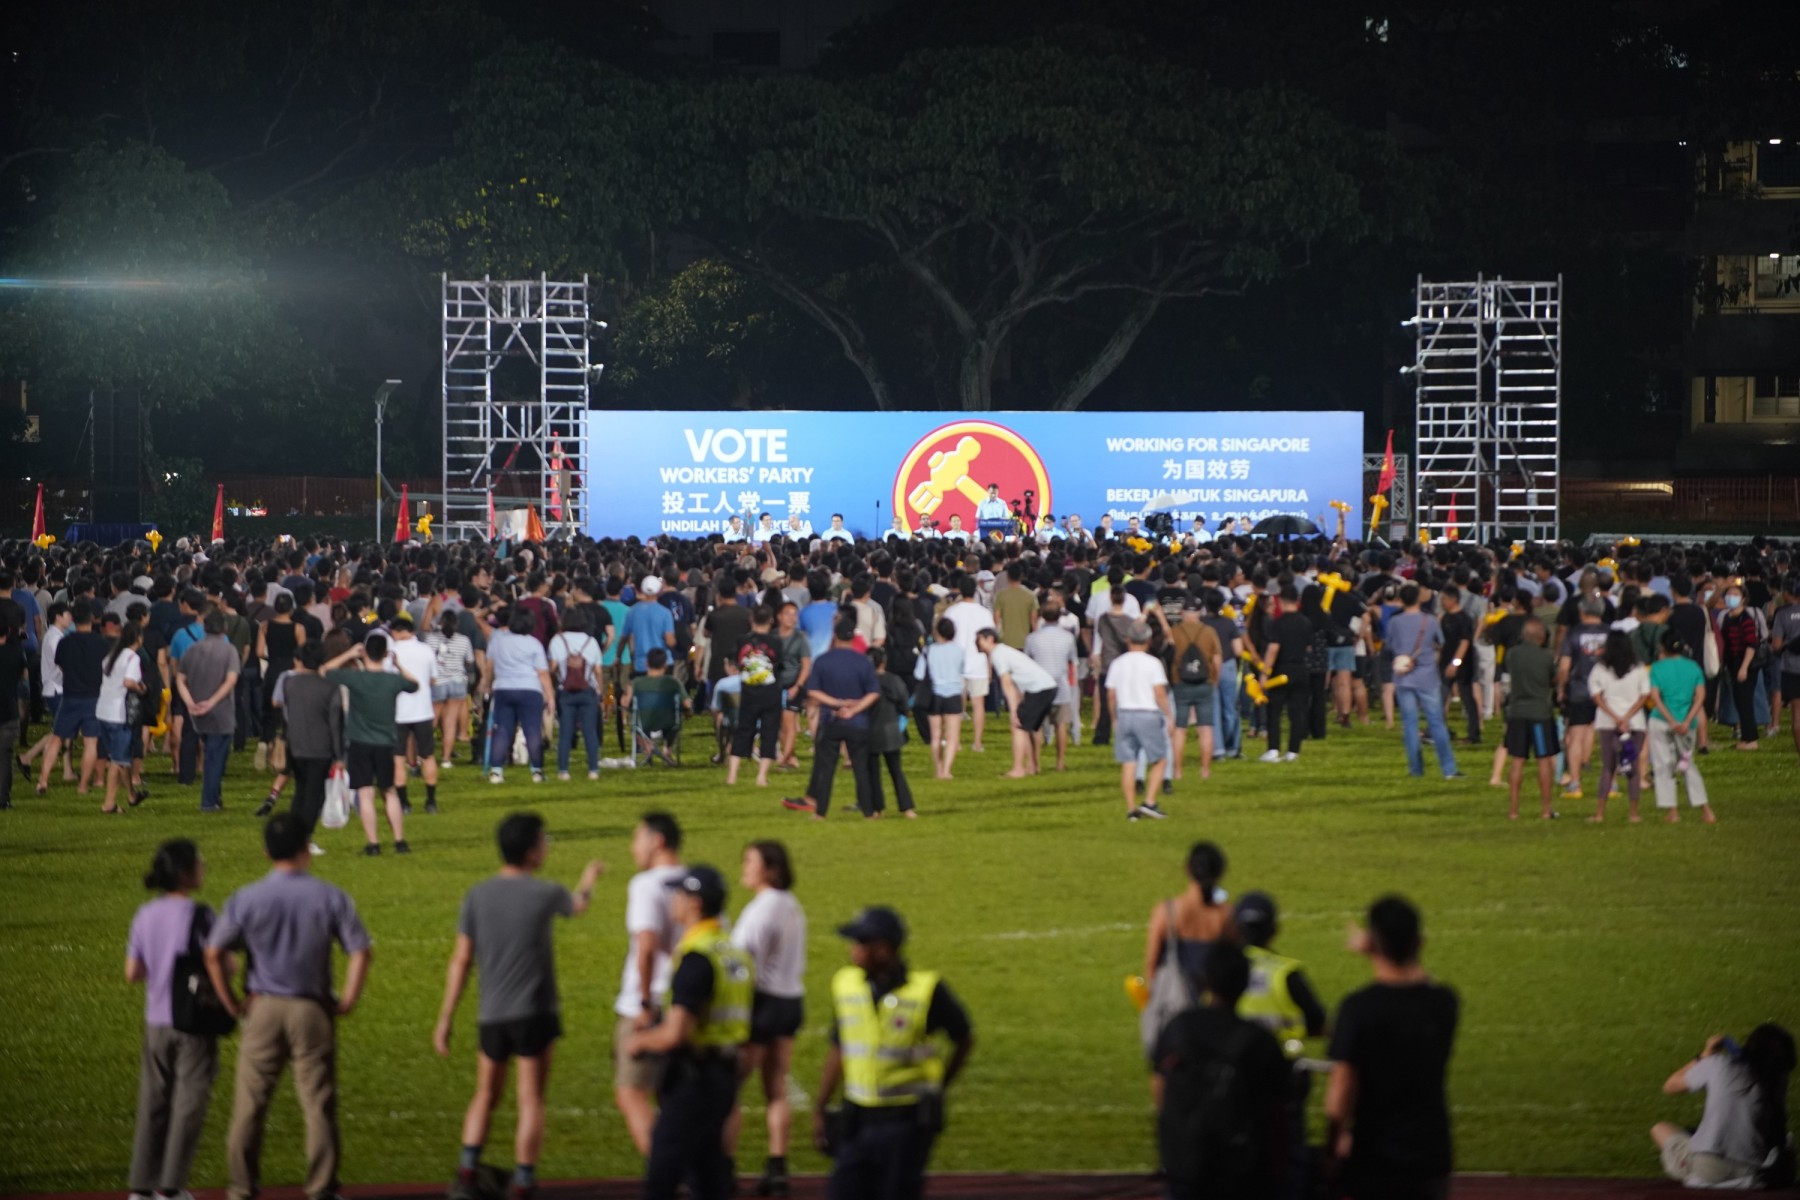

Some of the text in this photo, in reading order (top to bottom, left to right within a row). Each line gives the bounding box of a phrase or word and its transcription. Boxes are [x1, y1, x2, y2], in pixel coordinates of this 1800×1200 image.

[684, 428, 788, 463] VOTE
[1106, 437, 1310, 452] WORKING FOR SINGAPORE
[759, 467, 814, 484] PARTY
[1162, 458, 1251, 480] 为国效劳
[662, 490, 811, 514] 投工人党一票
[1223, 488, 1309, 502] SINGAPURA
[661, 520, 719, 532] UNDILAH
